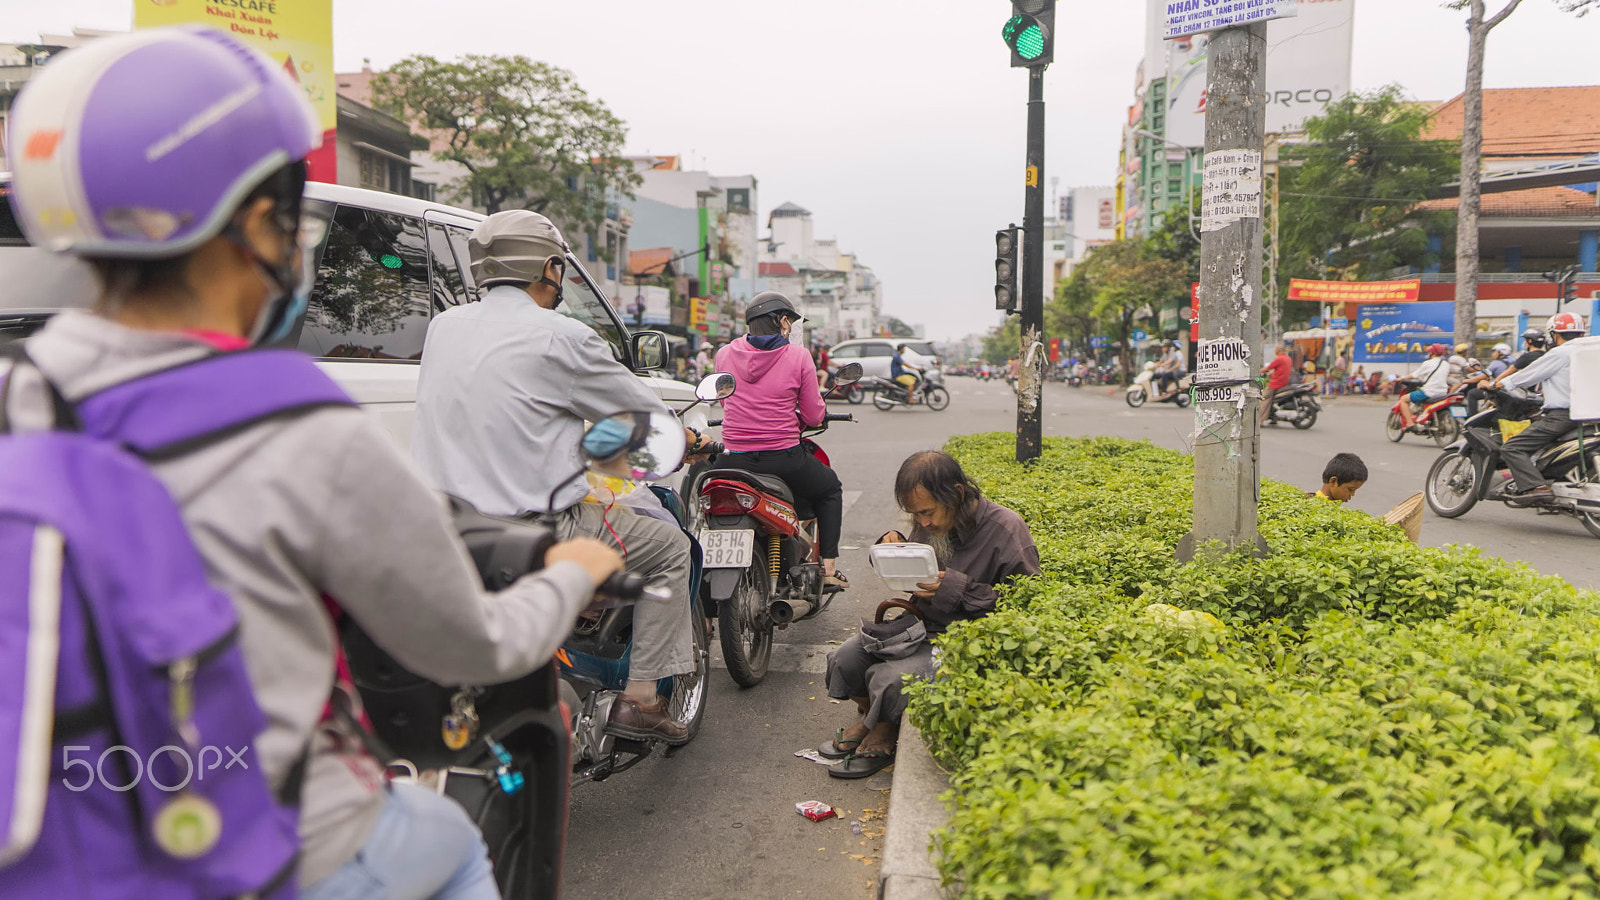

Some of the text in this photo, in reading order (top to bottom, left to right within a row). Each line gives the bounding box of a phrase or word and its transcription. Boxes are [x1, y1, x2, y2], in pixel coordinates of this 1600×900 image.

[205, 5, 236, 18] Khai
[707, 532, 744, 548] 63-H4
[705, 549, 744, 565] 5820
